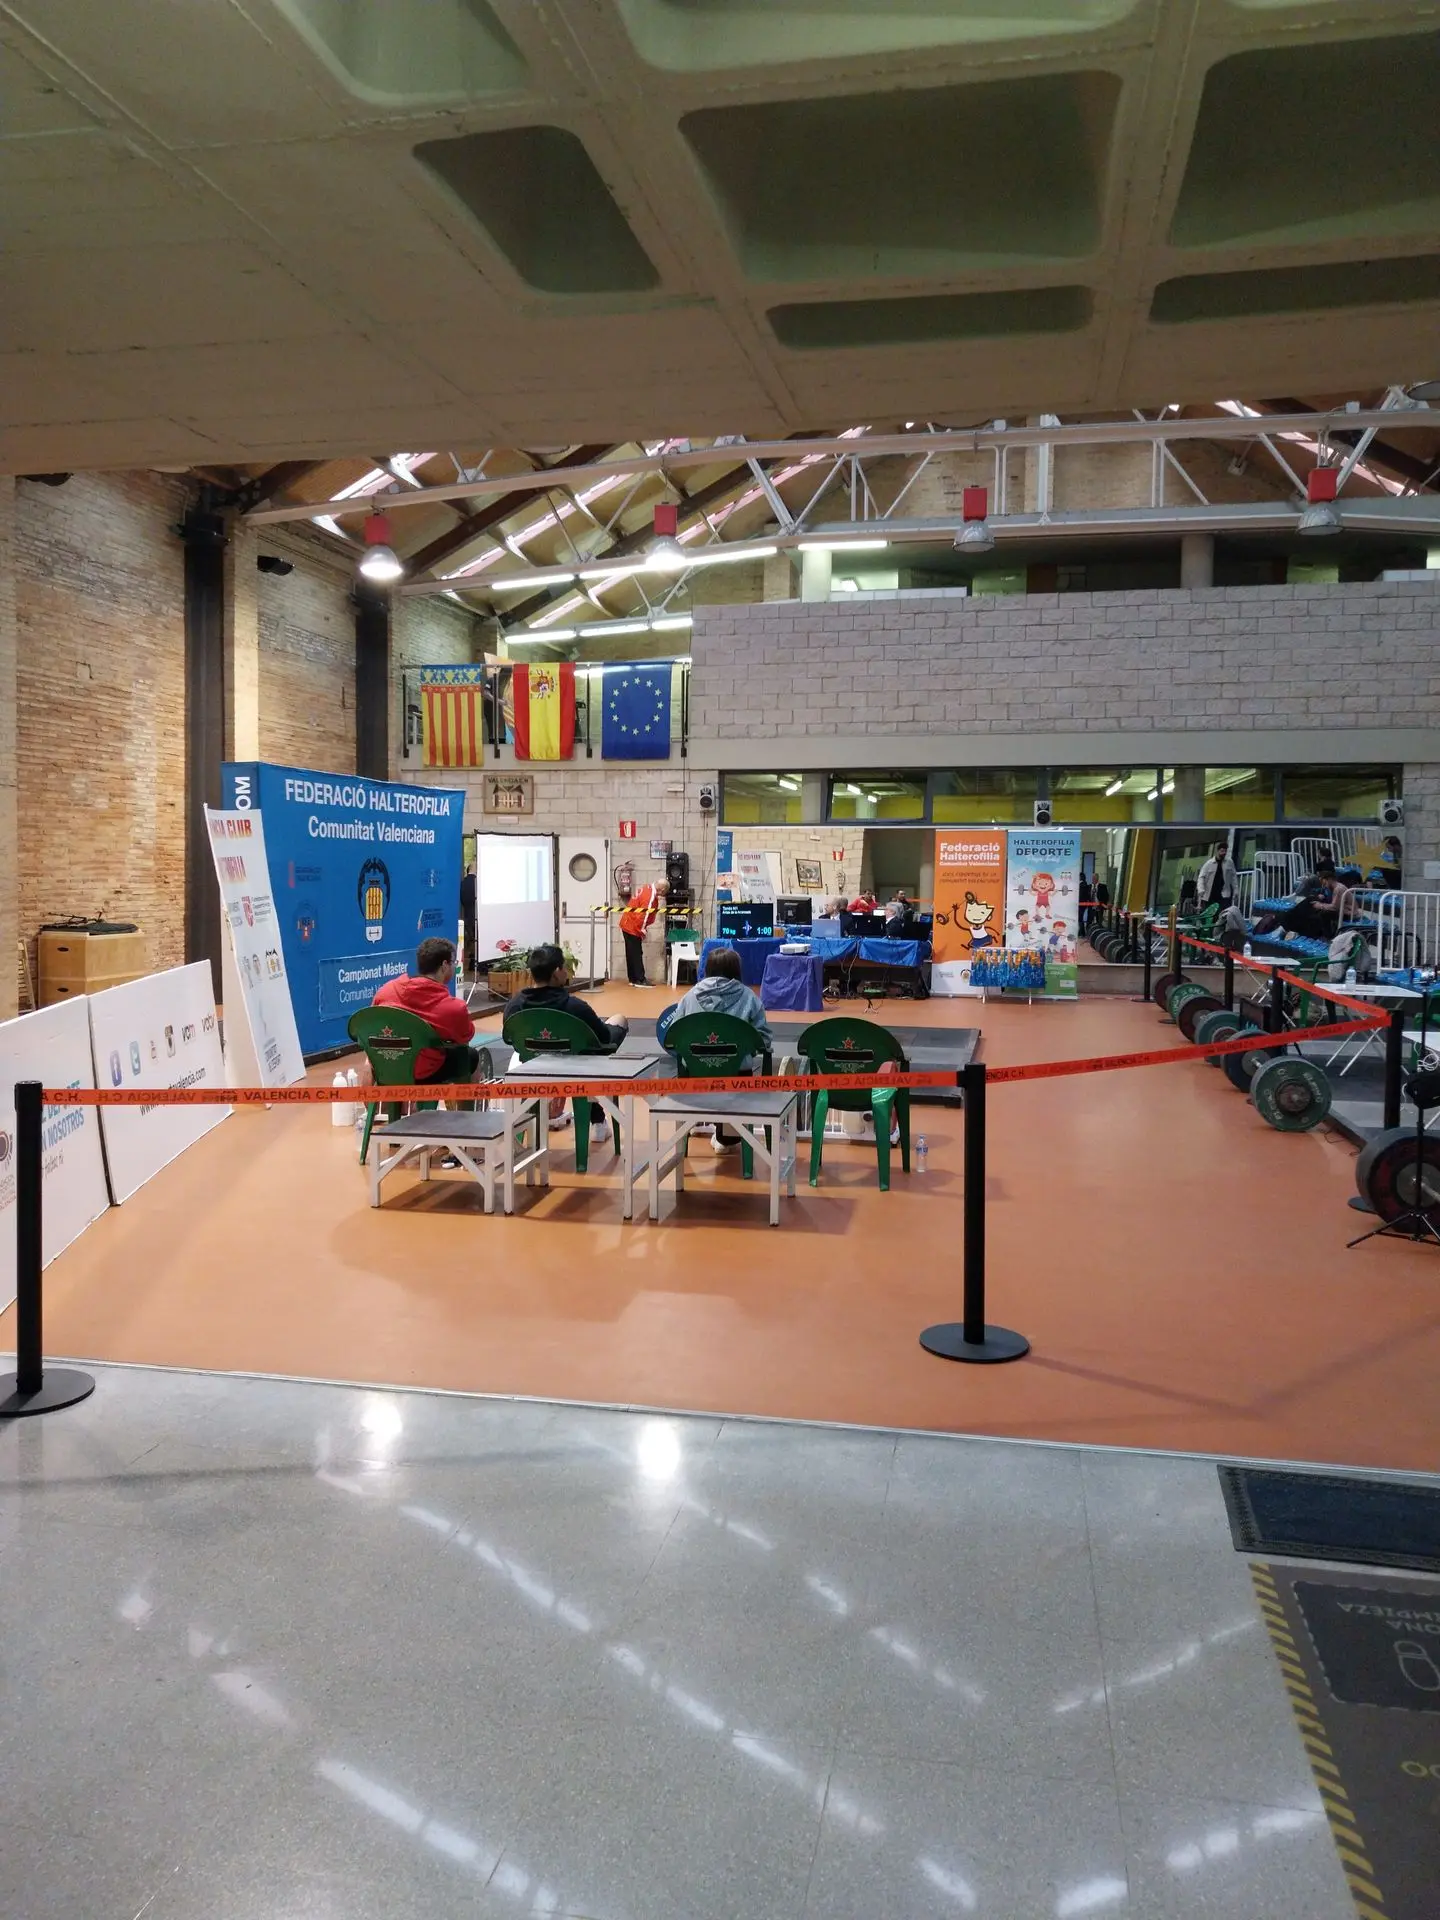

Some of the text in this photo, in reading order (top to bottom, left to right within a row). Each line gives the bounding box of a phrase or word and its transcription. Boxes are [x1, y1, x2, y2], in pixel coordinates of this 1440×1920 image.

[234, 776, 251, 810] OM
[284, 778, 450, 816] FEDERACIÓ HALTEROFILIA
[308, 815, 435, 844] Comunitat Valenciana
[940, 842, 1000, 852] Federació
[1015, 847, 1072, 856] DEPORTE
[940, 852, 1000, 861] Halterofilia
[757, 927, 772, 935] 1:00
[338, 967, 382, 984] Campionat
[339, 984, 374, 1004] Comunitat
[985, 1070, 1009, 1081] ENCIA
[496, 1084, 589, 1097] VALENCIA C.H.
[731, 1078, 819, 1090] VALENCIA C.H.
[53, 1091, 82, 1103] C.H.
[243, 1088, 343, 1101] VALENCIA C.H.
[48, 1106, 85, 1147] NOSOTROS
[1386, 1617, 1440, 1636] ONA
